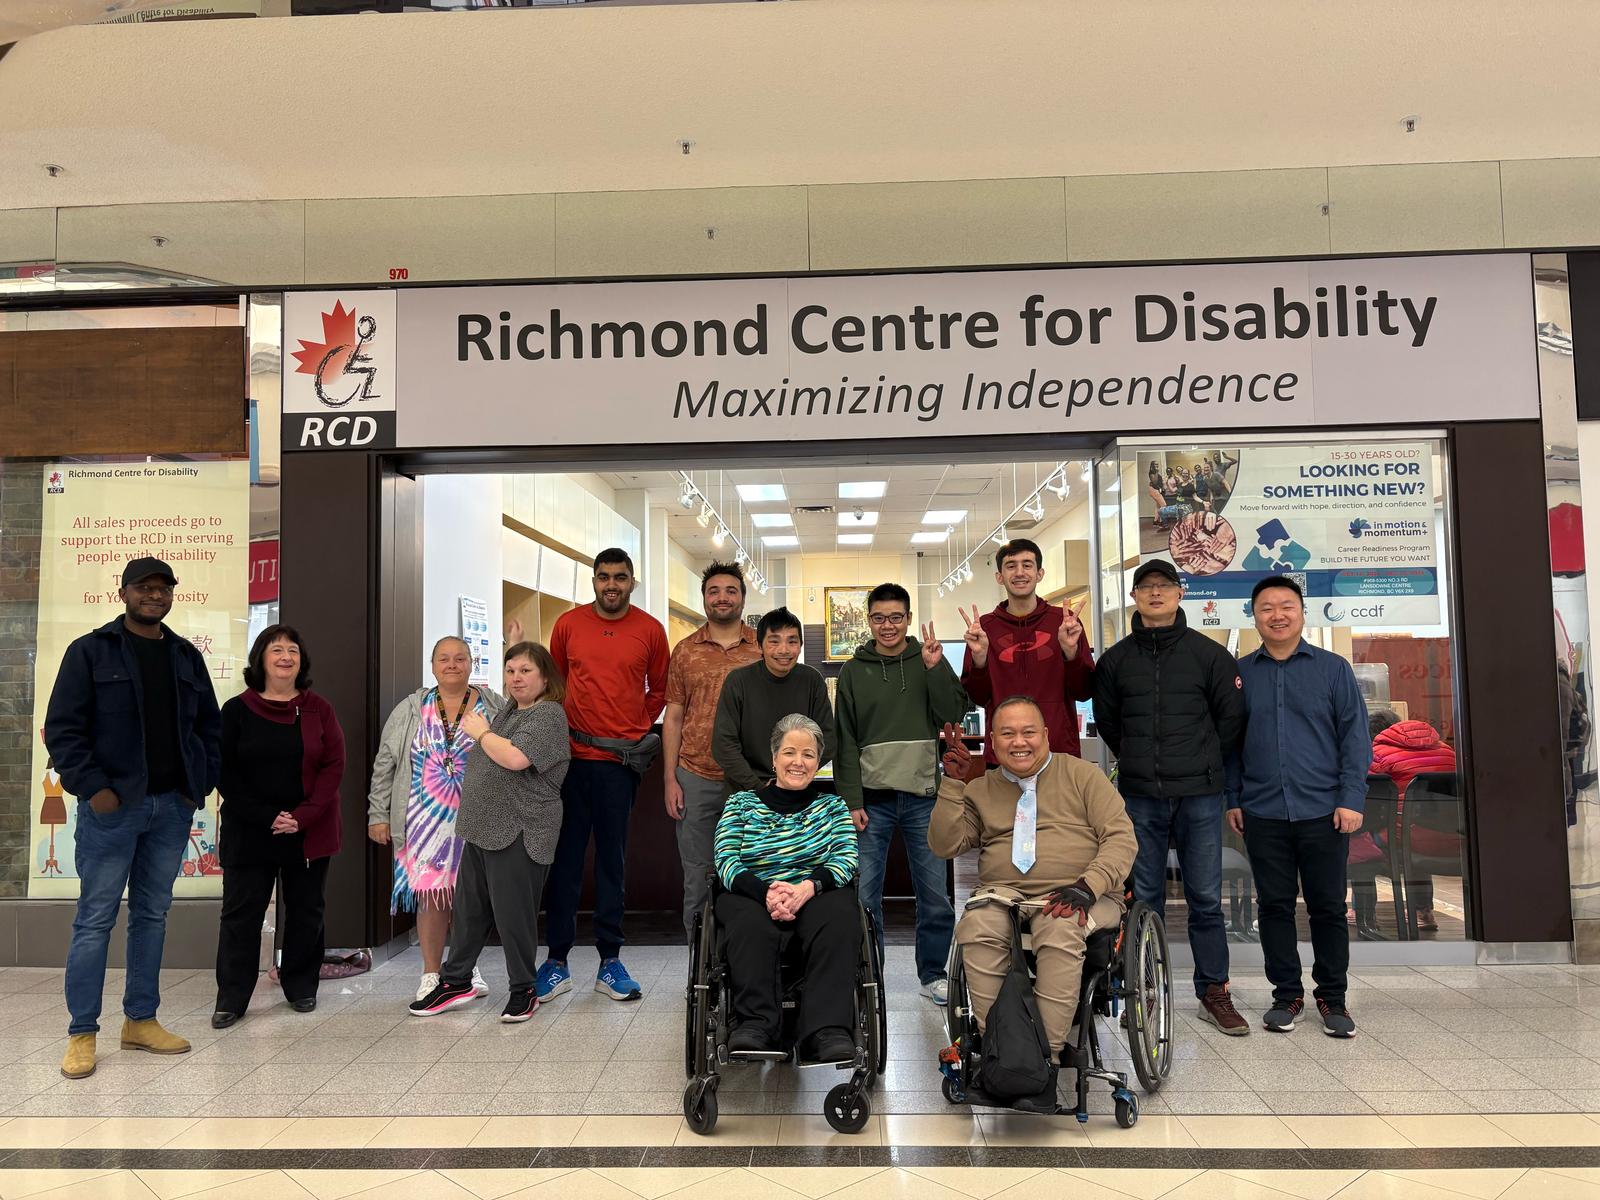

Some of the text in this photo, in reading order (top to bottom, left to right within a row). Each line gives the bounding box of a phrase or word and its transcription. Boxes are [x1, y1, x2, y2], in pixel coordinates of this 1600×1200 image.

[389, 268, 408, 280] 970
[457, 285, 1437, 361] Richmond Centre for Disability
[673, 364, 1299, 422] Maximizing Independence
[300, 416, 378, 448] RCD
[1330, 450, 1420, 460] 15-30 YEARS OLD?
[68, 468, 199, 478] Richmond Centre for Disability
[1300, 462, 1420, 478] LOOKING FOR
[1263, 482, 1425, 499] SOMETHING NEW?
[1261, 503, 1290, 511] forward
[1310, 502, 1330, 511] hope,
[1332, 501, 1366, 510] direction,
[1384, 500, 1427, 508] confidence
[72, 515, 222, 531] All sales proceeds go to
[1373, 521, 1382, 529] in
[1384, 520, 1420, 529] motion
[61, 532, 234, 548] support the RCD in serving
[77, 548, 217, 565] people with disability
[83, 592, 103, 604] for
[1351, 605, 1384, 617] ccdf
